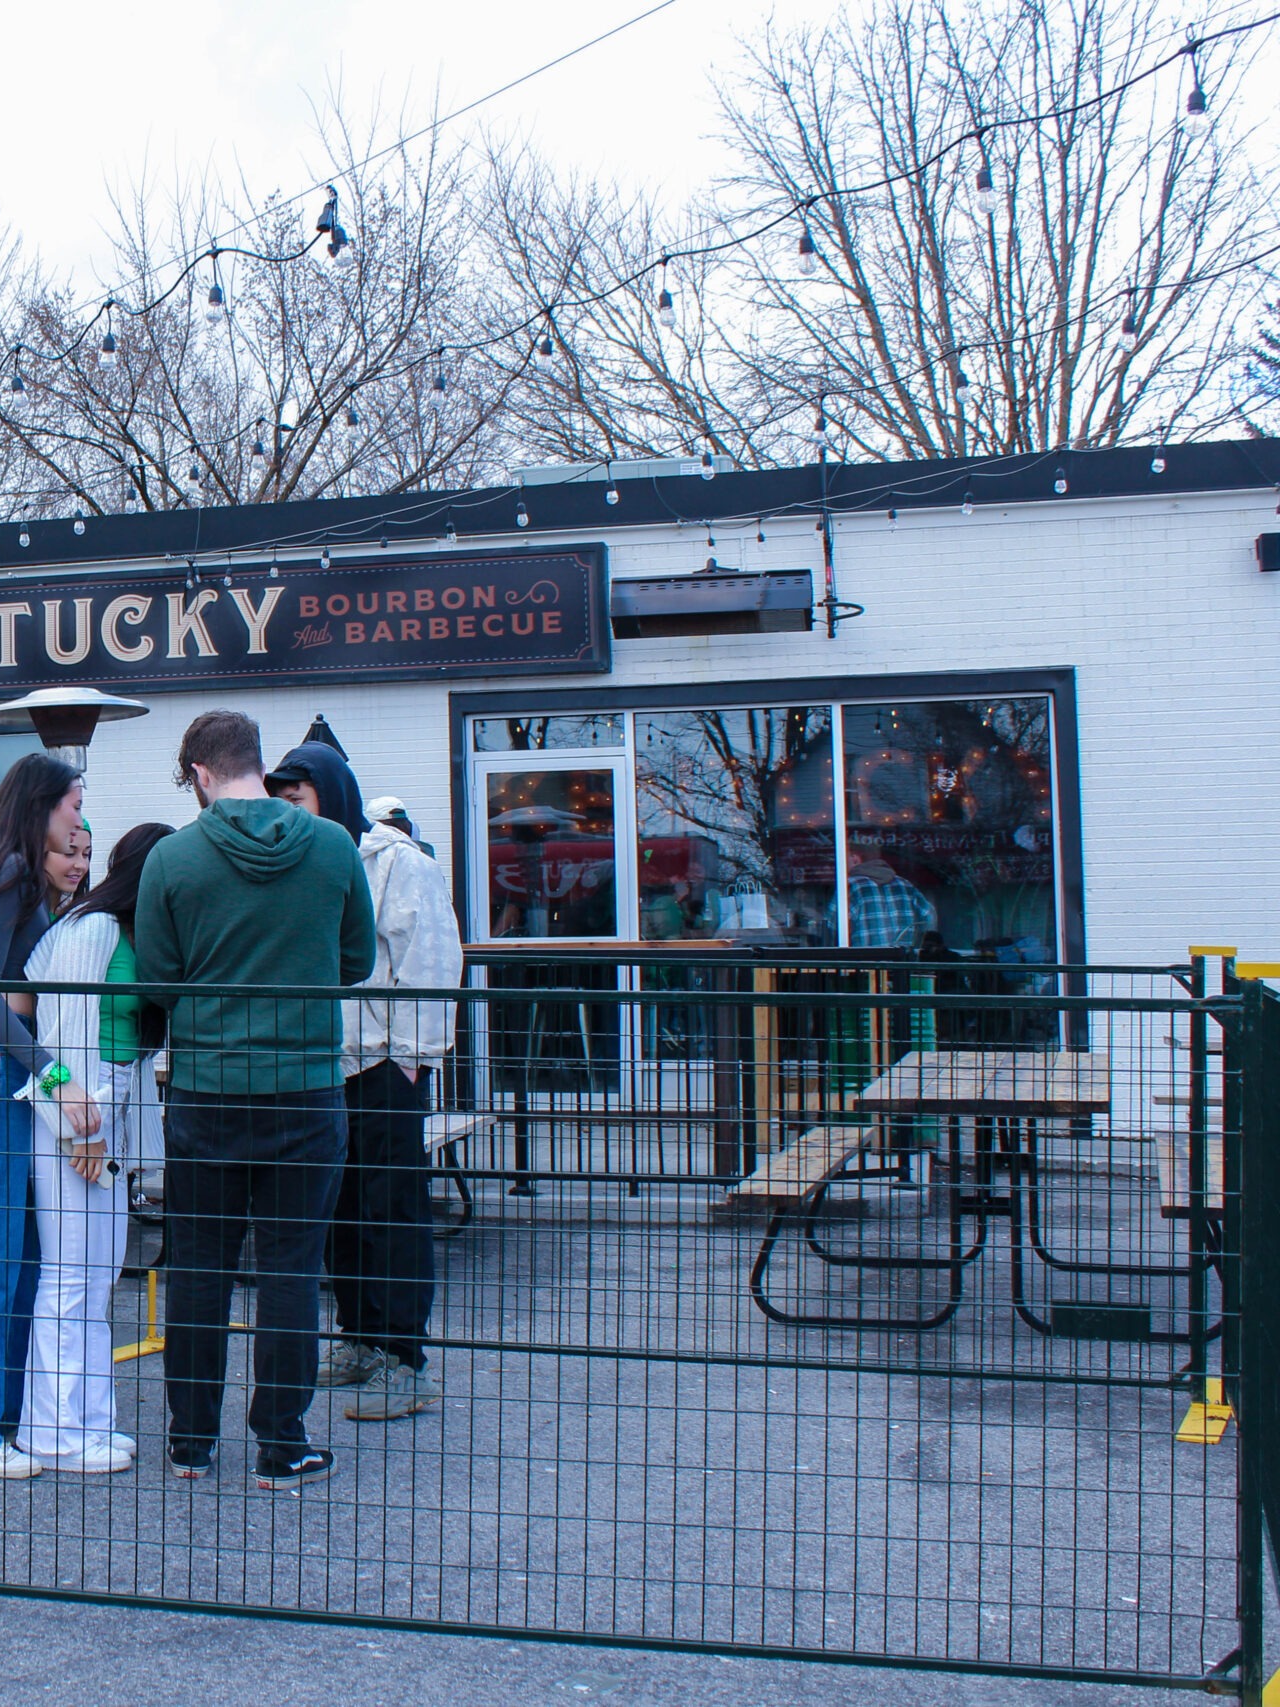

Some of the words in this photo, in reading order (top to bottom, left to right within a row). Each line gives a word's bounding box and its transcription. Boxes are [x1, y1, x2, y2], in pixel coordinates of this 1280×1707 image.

[299, 585, 496, 618] BOURBON
[291, 621, 333, 650] And
[345, 611, 562, 644] BARBECUE
